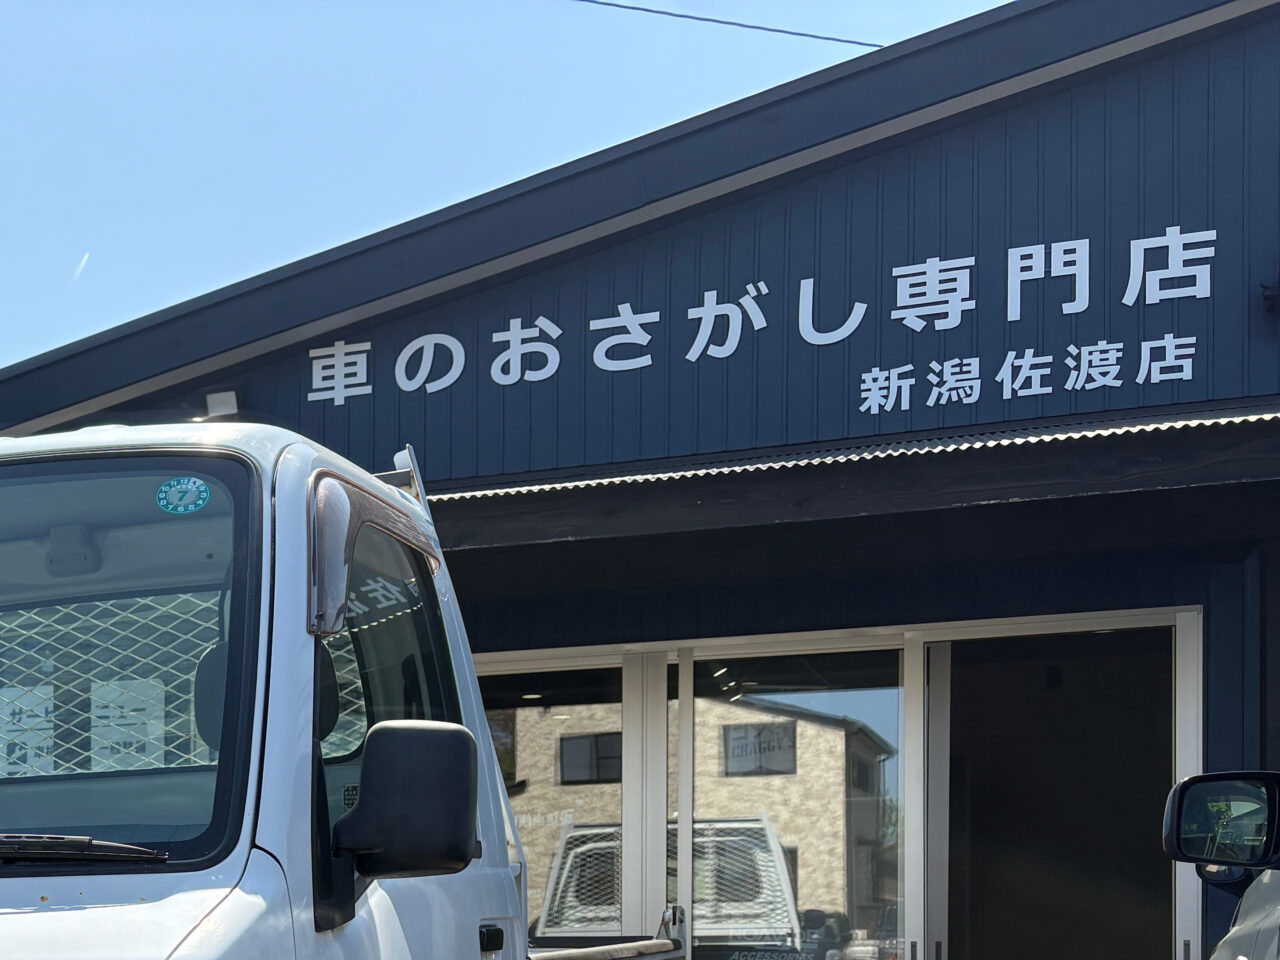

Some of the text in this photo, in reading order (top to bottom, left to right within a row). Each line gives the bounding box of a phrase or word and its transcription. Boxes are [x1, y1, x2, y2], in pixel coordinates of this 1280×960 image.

[307, 226, 1217, 406] 車のおさがし専門店
[859, 333, 1197, 415] 新潟佐渡店
[178, 490, 189, 502] 7
